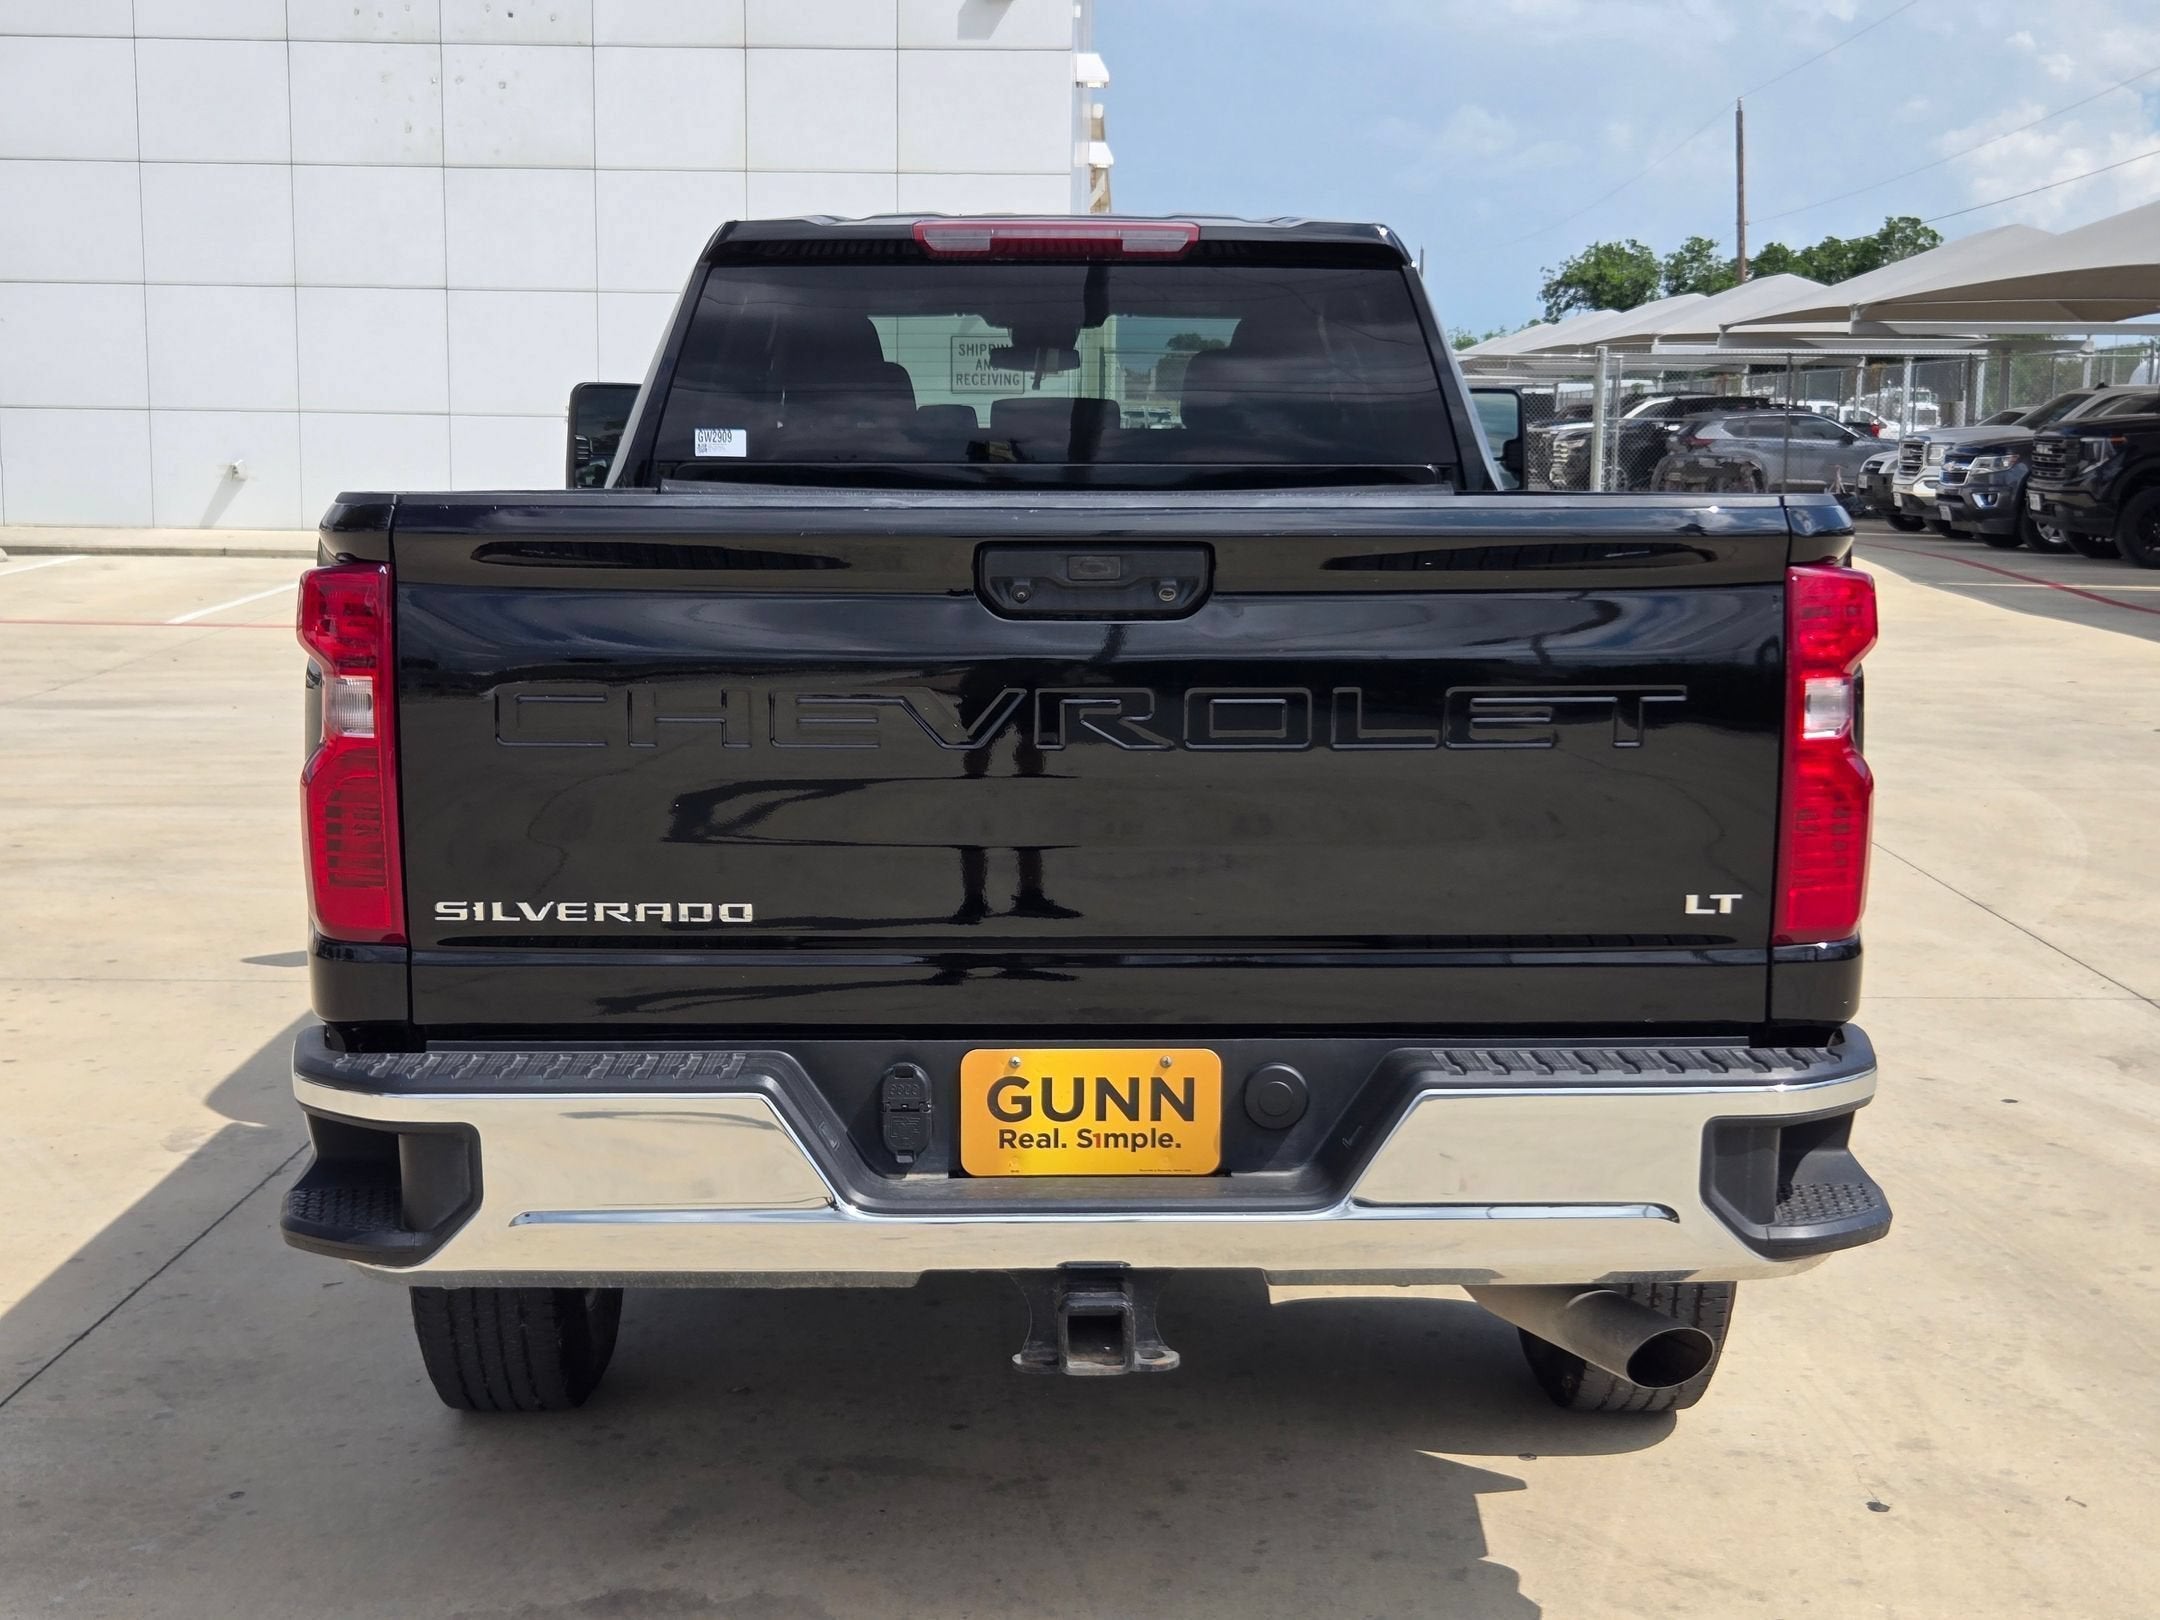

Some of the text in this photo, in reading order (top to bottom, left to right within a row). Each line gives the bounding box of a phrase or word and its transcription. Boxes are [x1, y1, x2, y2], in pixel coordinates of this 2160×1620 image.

[958, 343, 1010, 356] SHIPP
[975, 358, 999, 371] AN
[956, 373, 1020, 386] RECEIVING
[494, 684, 1687, 751] CHEVROLET
[434, 900, 754, 923] SILVERADO
[1684, 893, 1743, 914] LT
[987, 1075, 1195, 1123] GUNN
[998, 1127, 1067, 1149] Real.
